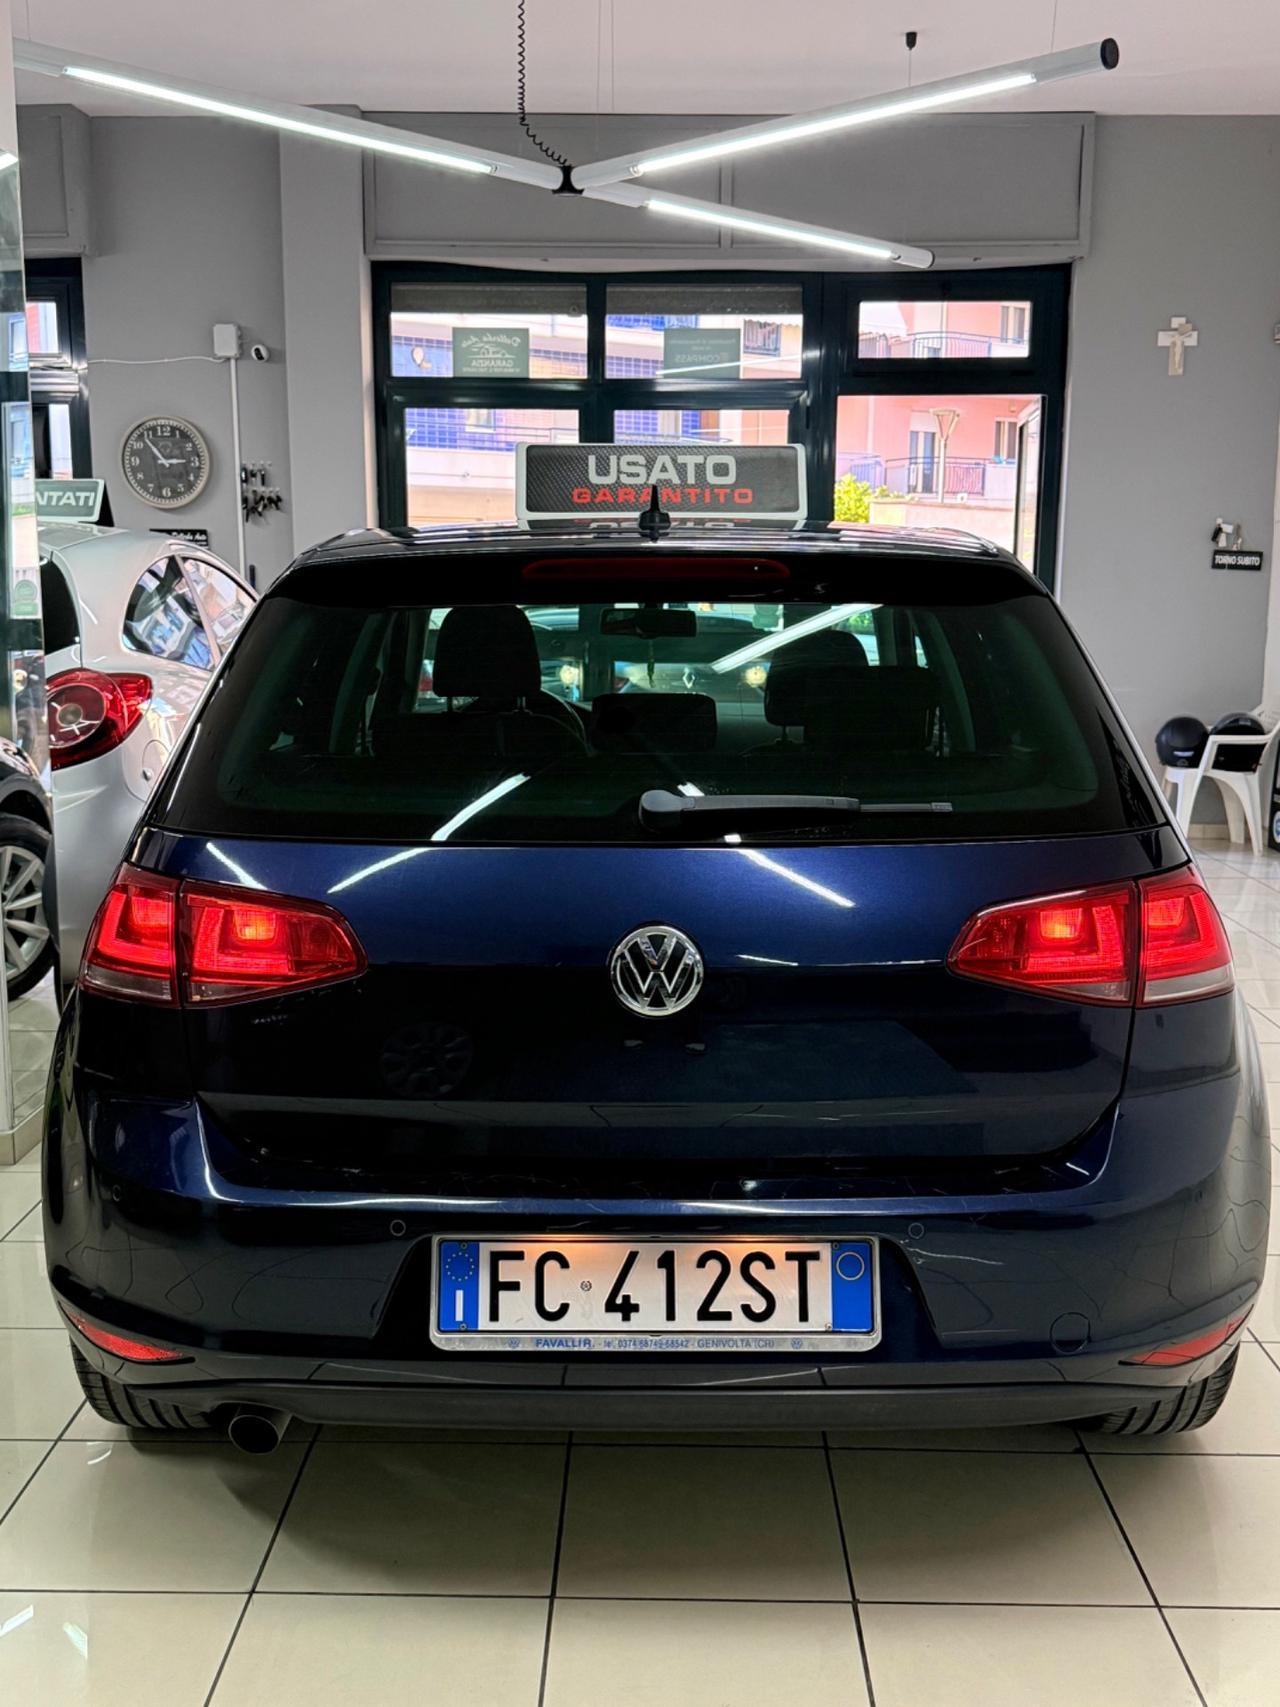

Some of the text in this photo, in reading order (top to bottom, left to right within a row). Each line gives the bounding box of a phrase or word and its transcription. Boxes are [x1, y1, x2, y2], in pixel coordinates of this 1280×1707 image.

[157, 426, 171, 436] 12
[133, 441, 143, 449] 10
[186, 442, 193, 451] 2
[131, 456, 140, 466] 9
[190, 456, 199, 467] 3
[588, 454, 737, 485] USATO
[137, 472, 144, 480] 8
[188, 472, 194, 481] 4
[147, 483, 154, 492] 7
[162, 487, 171, 498] 6
[177, 483, 184, 492] 5
[571, 487, 753, 504] GARANTITO
[1214, 555, 1260, 566] TORNO SUBITO
[489, 1250, 820, 1322] FC 412ST
[454, 1289, 463, 1321] I
[697, 1338, 753, 1348] GENIVOLTA
